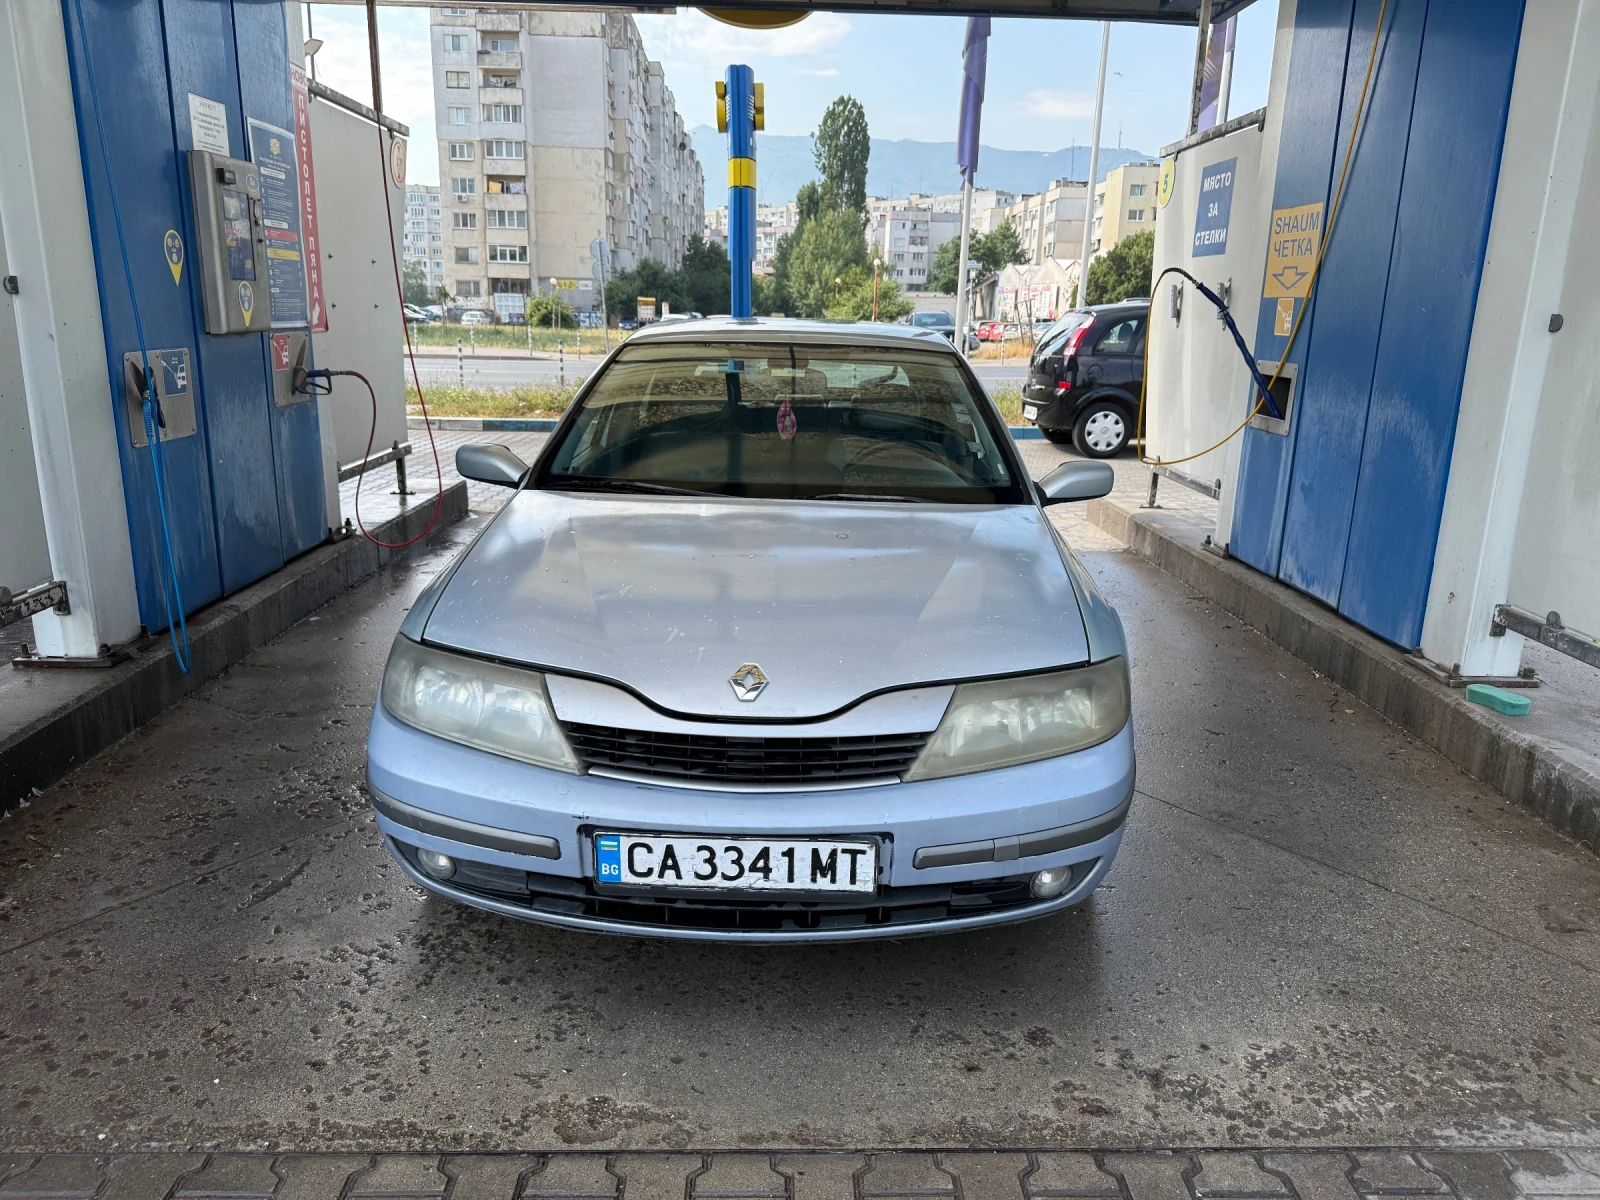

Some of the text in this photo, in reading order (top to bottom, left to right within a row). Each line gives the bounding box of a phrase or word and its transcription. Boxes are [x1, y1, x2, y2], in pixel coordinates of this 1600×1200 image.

[1163, 172, 1169, 194] 5
[1203, 171, 1232, 192] МЯСТО
[298, 94, 319, 299] ПИСТОЛЕТ ПЯНА
[1207, 202, 1218, 218] ЗА
[1274, 211, 1320, 235] SHAUM
[1194, 227, 1227, 246] СТЕЛКИ
[1273, 237, 1313, 258] ЧЕТКА
[601, 863, 619, 875] BG
[627, 842, 868, 886] CA 3341 MT
